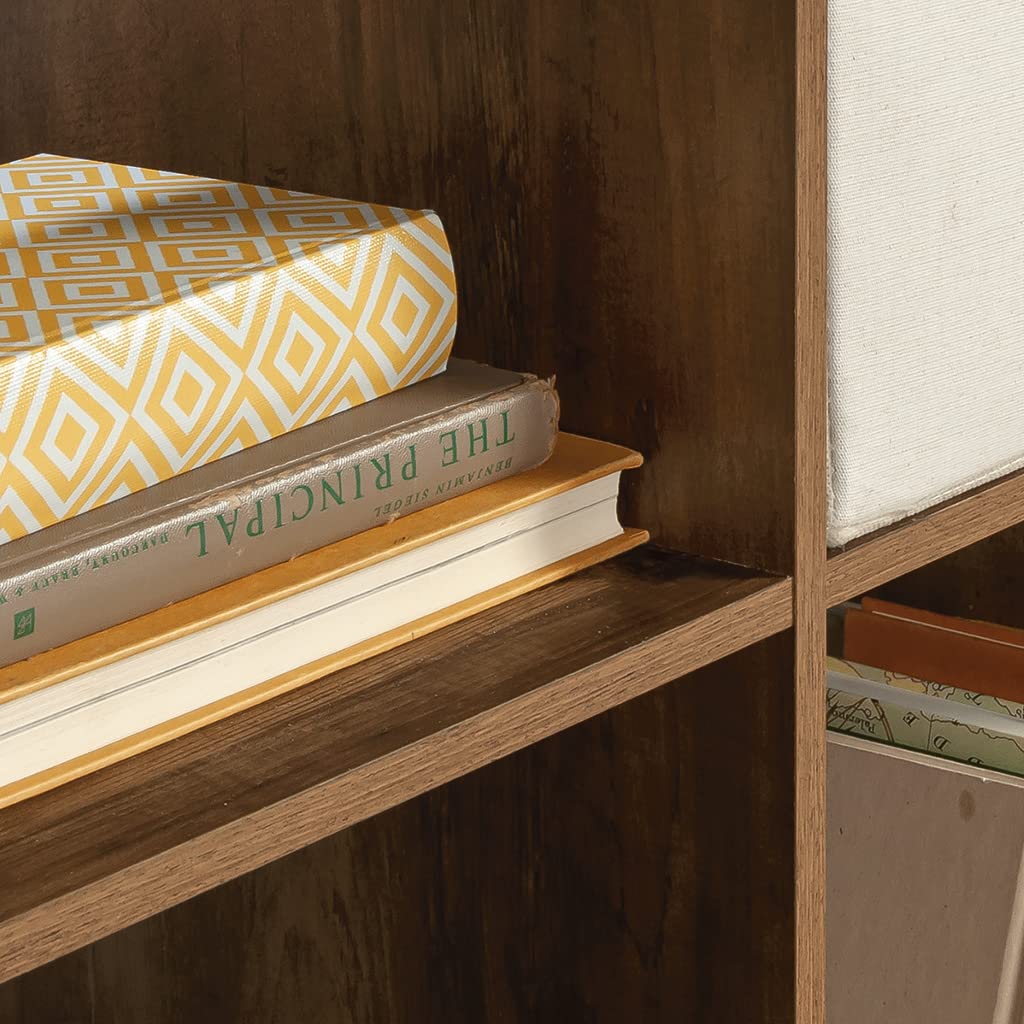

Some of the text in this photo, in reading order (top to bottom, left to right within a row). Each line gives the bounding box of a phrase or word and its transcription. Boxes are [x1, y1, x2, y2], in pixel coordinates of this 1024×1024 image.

[185, 409, 516, 558] THE PRINCIPAL
[372, 456, 513, 519] BENJAMIN SIEGEL
